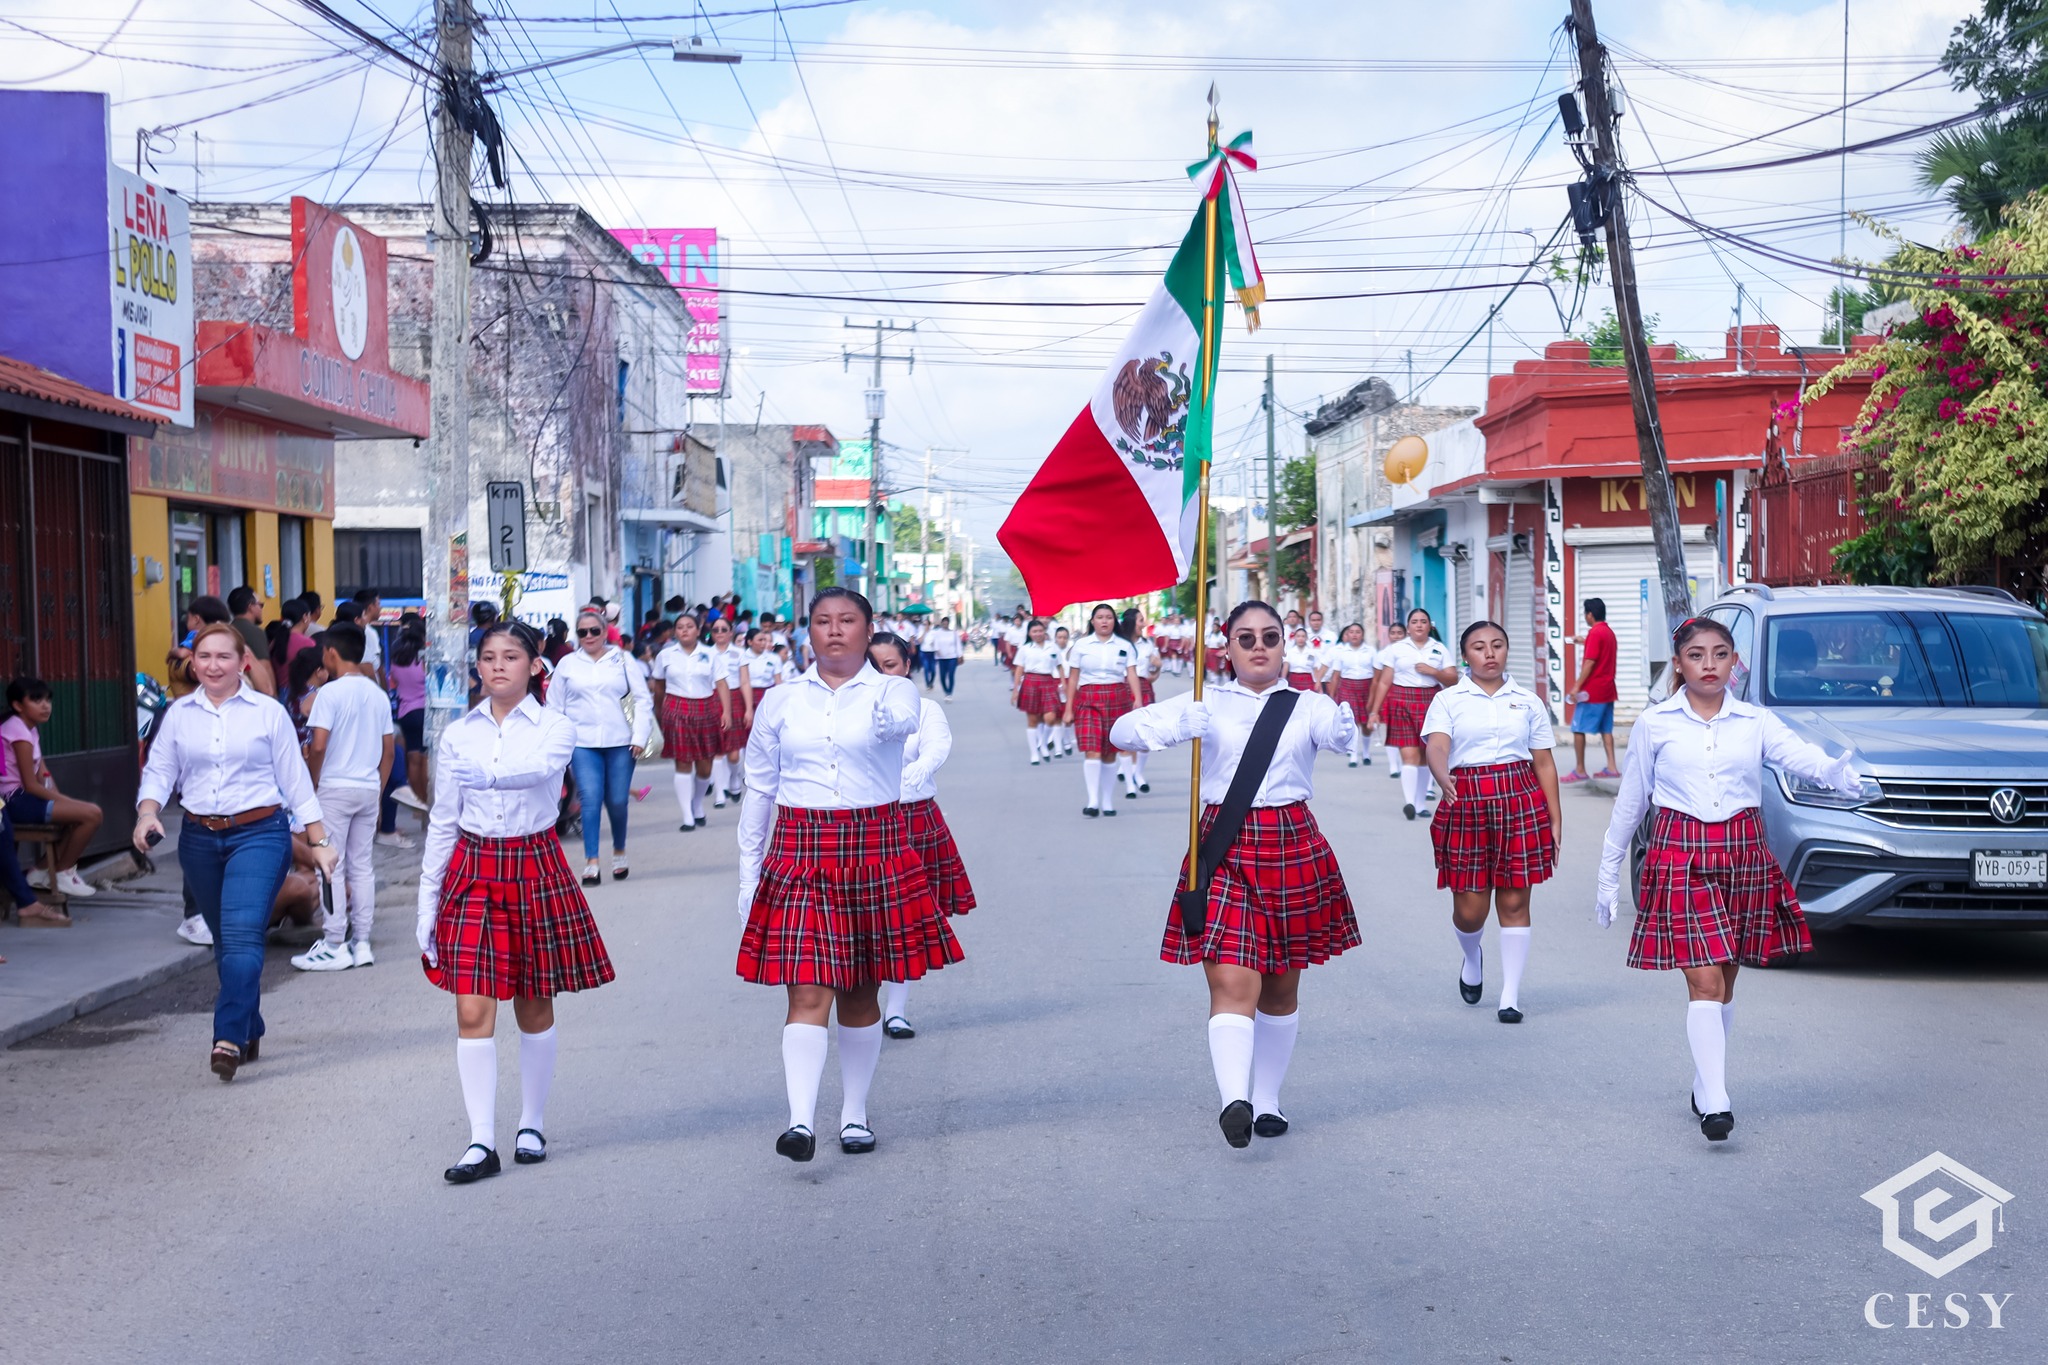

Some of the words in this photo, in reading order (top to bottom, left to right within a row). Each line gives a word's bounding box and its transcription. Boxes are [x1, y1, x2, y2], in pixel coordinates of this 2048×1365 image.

[124, 184, 169, 244] LEÑA
[129, 234, 177, 305] POLLO
[301, 348, 355, 411] COMIDA
[359, 369, 398, 421] CHINA
[491, 485, 519, 499] km
[1601, 476, 1695, 512] IKTN
[1977, 860, 2045, 876] YYB-059-E
